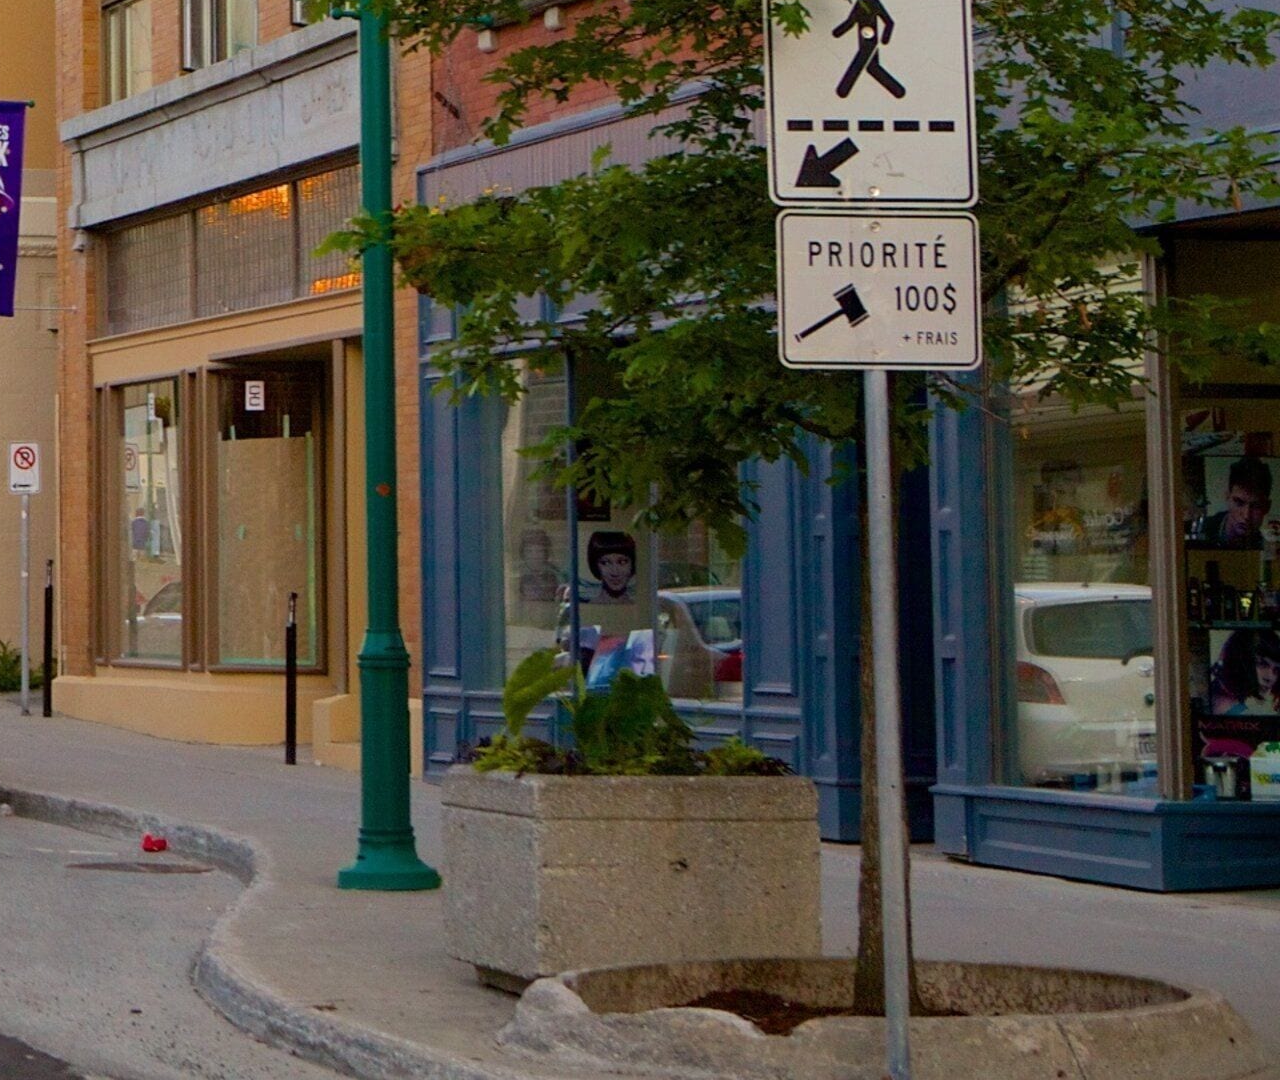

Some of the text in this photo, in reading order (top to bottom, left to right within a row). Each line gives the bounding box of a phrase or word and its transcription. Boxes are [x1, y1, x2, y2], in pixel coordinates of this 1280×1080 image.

[808, 235, 948, 269] PRIORITÉ
[894, 282, 958, 314] 100$
[916, 331, 959, 346] FRAIS
